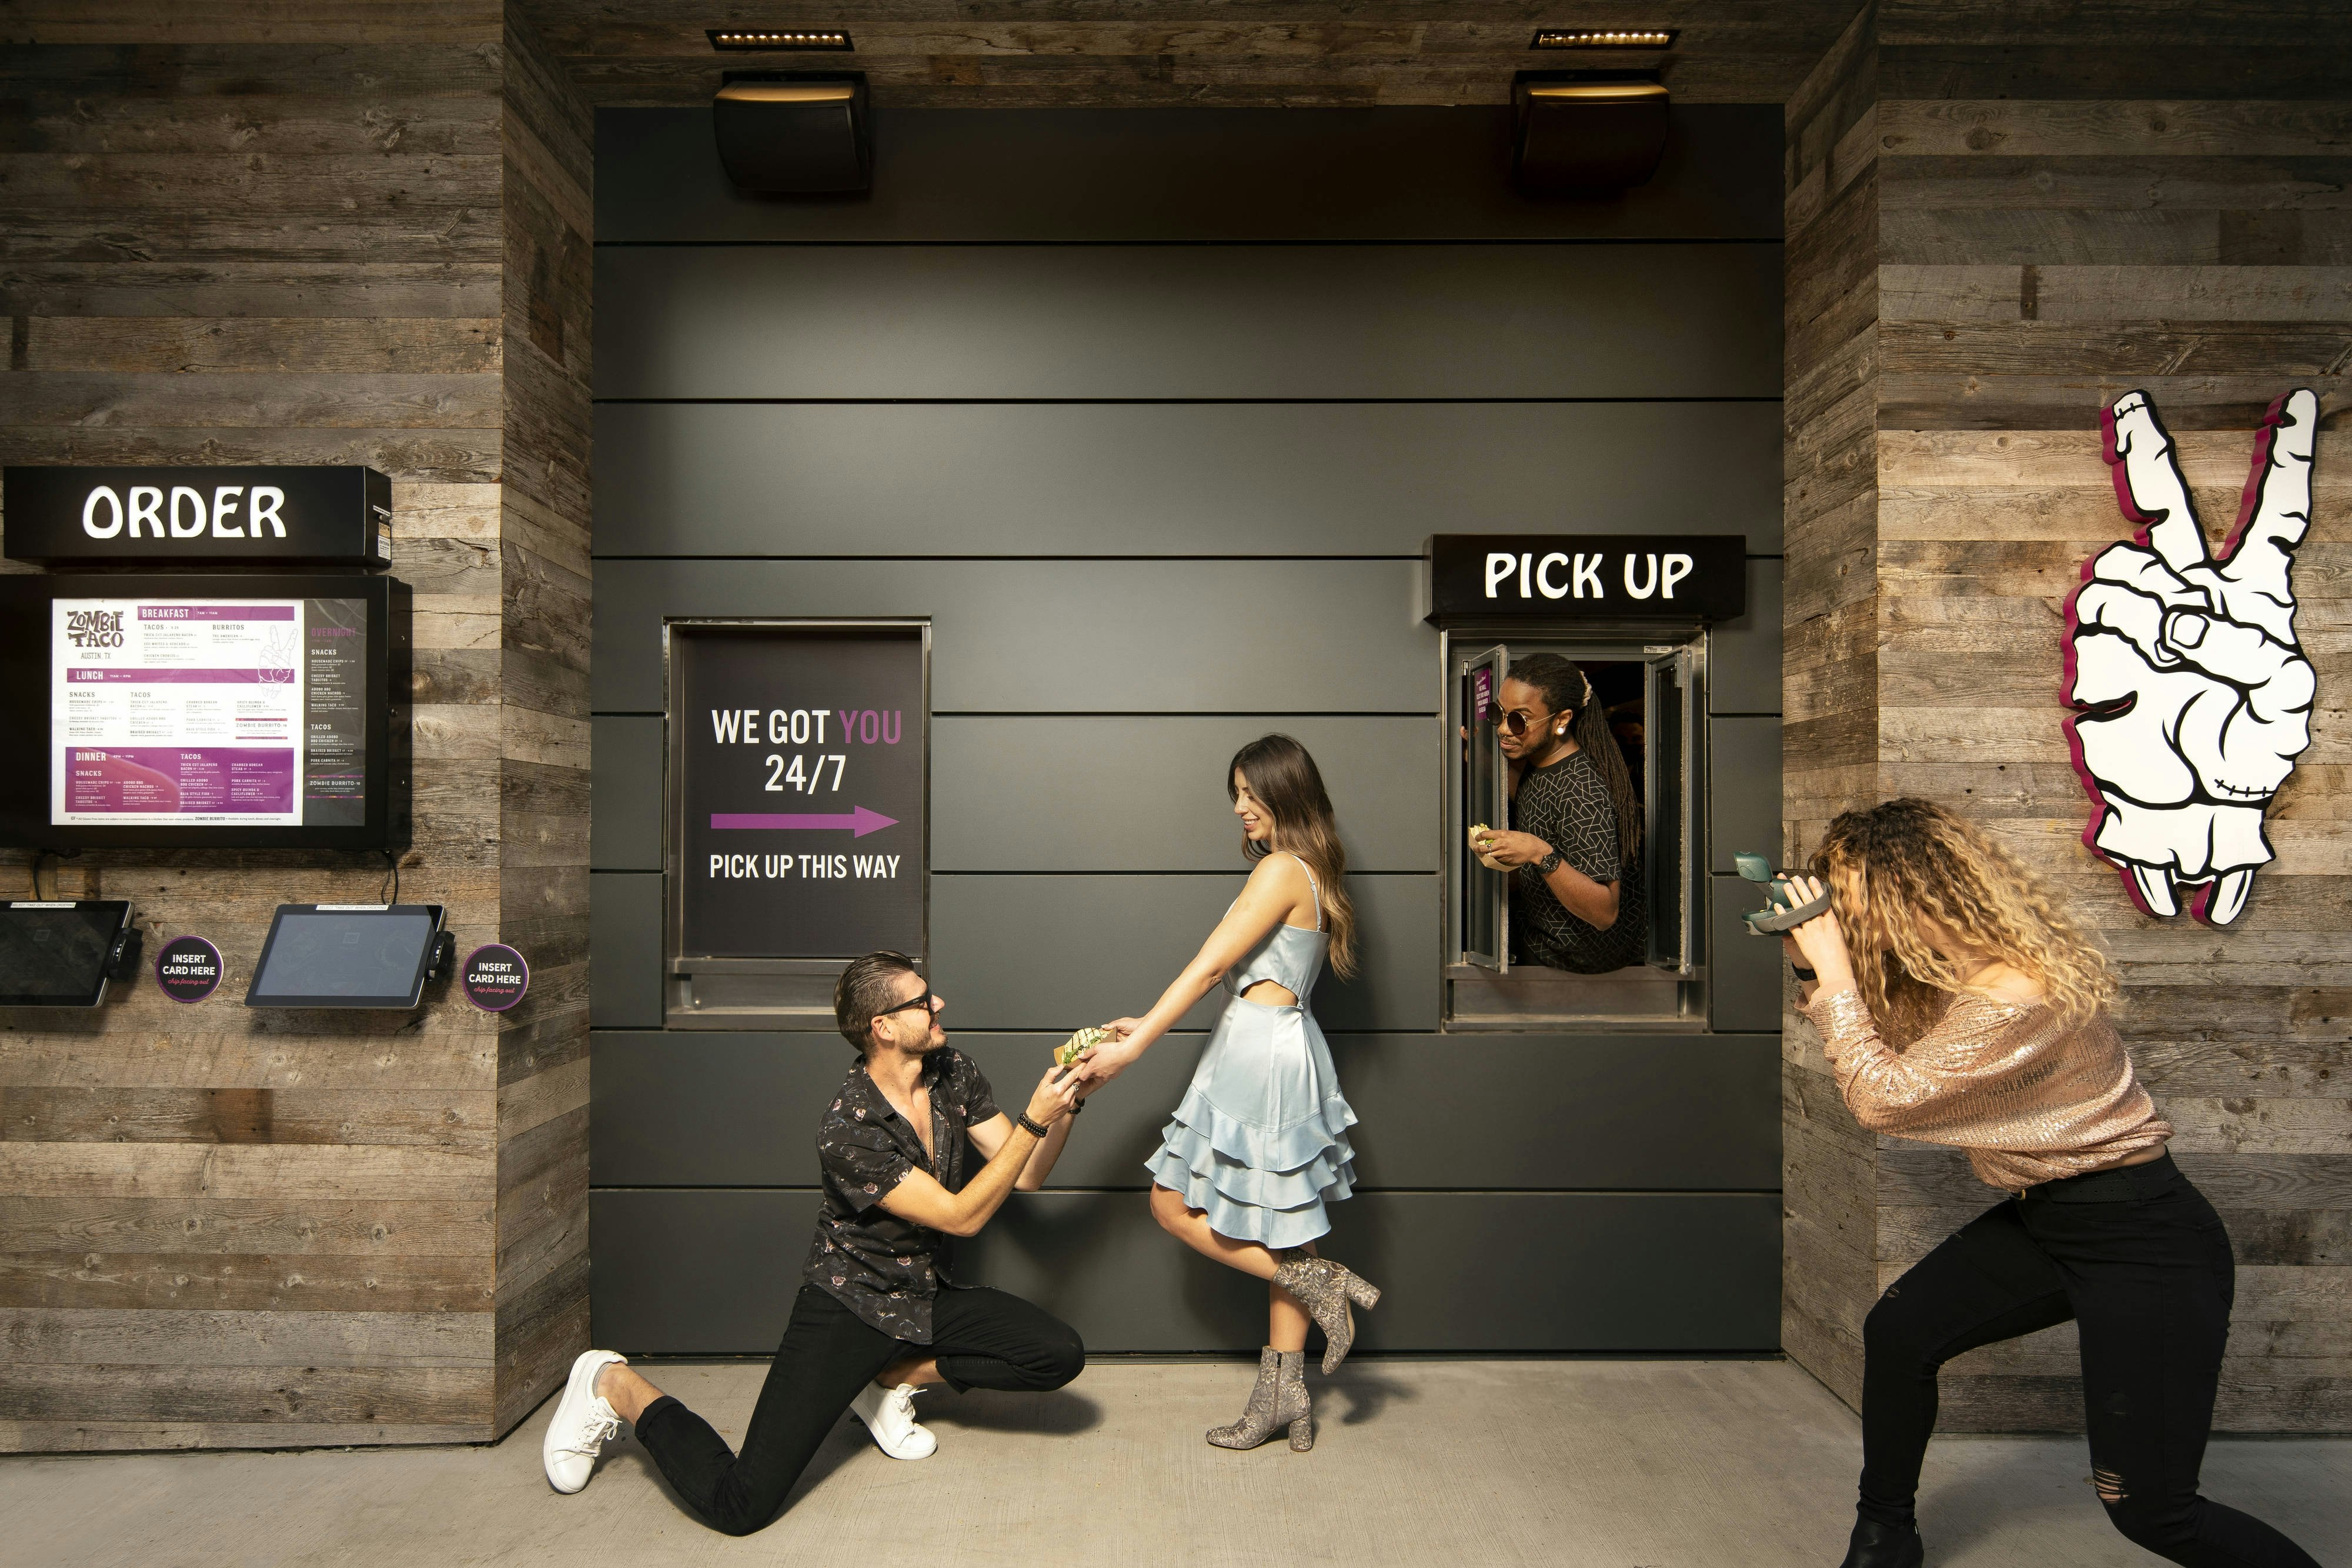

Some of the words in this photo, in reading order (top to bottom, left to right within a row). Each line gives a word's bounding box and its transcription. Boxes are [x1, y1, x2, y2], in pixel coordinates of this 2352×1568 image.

[83, 485, 286, 539] ORDER
[1485, 553, 1603, 599] PICK
[1624, 553, 1693, 600] UP
[142, 609, 189, 618] BREAKFAST
[312, 628, 356, 636] OVERNIGHT
[68, 631, 124, 647] TACO
[76, 671, 103, 680] LUNCH
[711, 710, 760, 744] WE
[769, 709, 830, 744] GOT
[838, 710, 901, 744] YOU
[76, 752, 106, 761] DINNER
[764, 754, 846, 794] 24/7
[710, 854, 759, 879] PICK
[765, 854, 793, 879] UP
[798, 854, 847, 879] THIS
[852, 854, 900, 879] WAY
[173, 955, 206, 963] INSERT
[163, 966, 188, 975] CARD
[191, 967, 215, 975] HERE
[479, 962, 512, 972] INSERT
[469, 974, 494, 983] CARD
[496, 975, 521, 984] HERE
